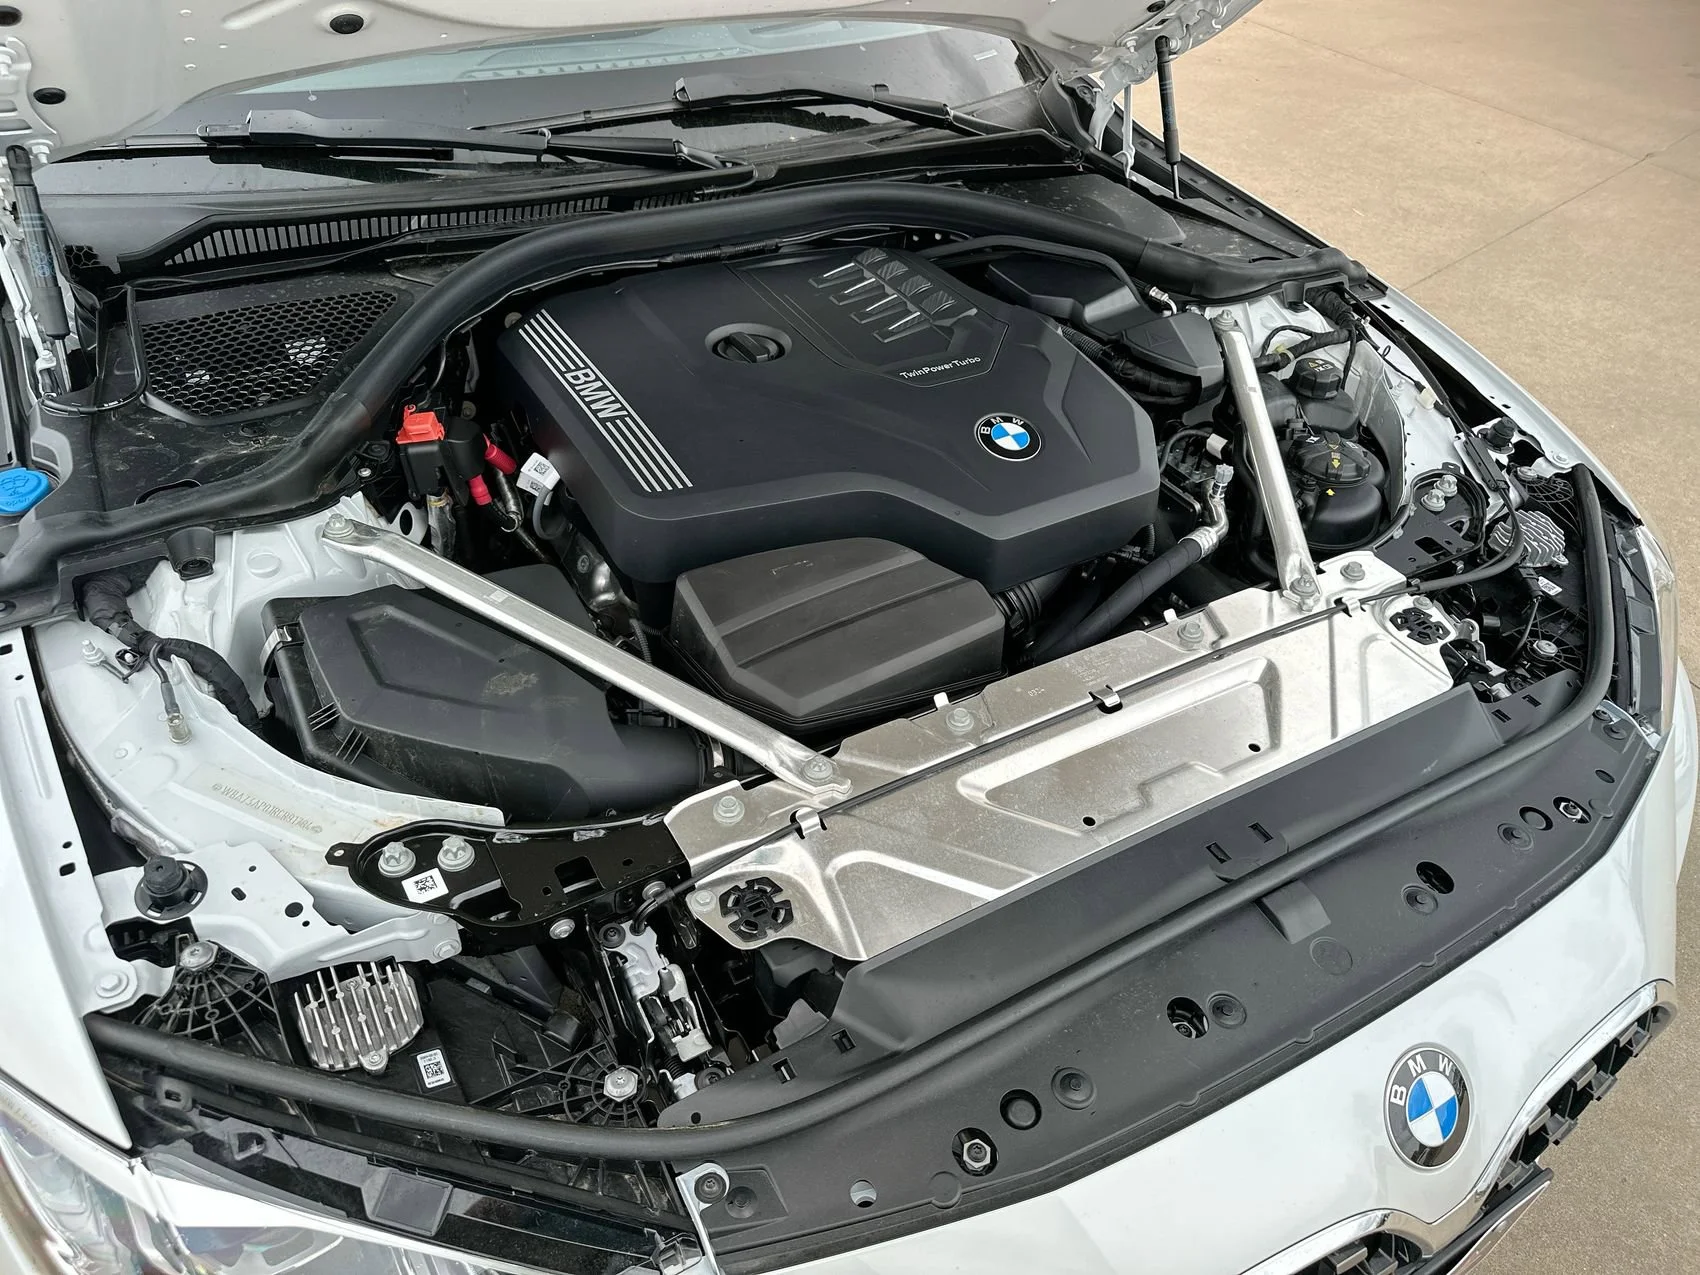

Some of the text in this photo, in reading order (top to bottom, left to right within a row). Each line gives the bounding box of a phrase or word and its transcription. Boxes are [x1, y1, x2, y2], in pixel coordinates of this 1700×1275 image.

[900, 356, 981, 379] TwinPowerTurbo
[564, 368, 629, 418] BMW
[980, 416, 1024, 435] BMW
[1389, 1053, 1453, 1107] BMW
